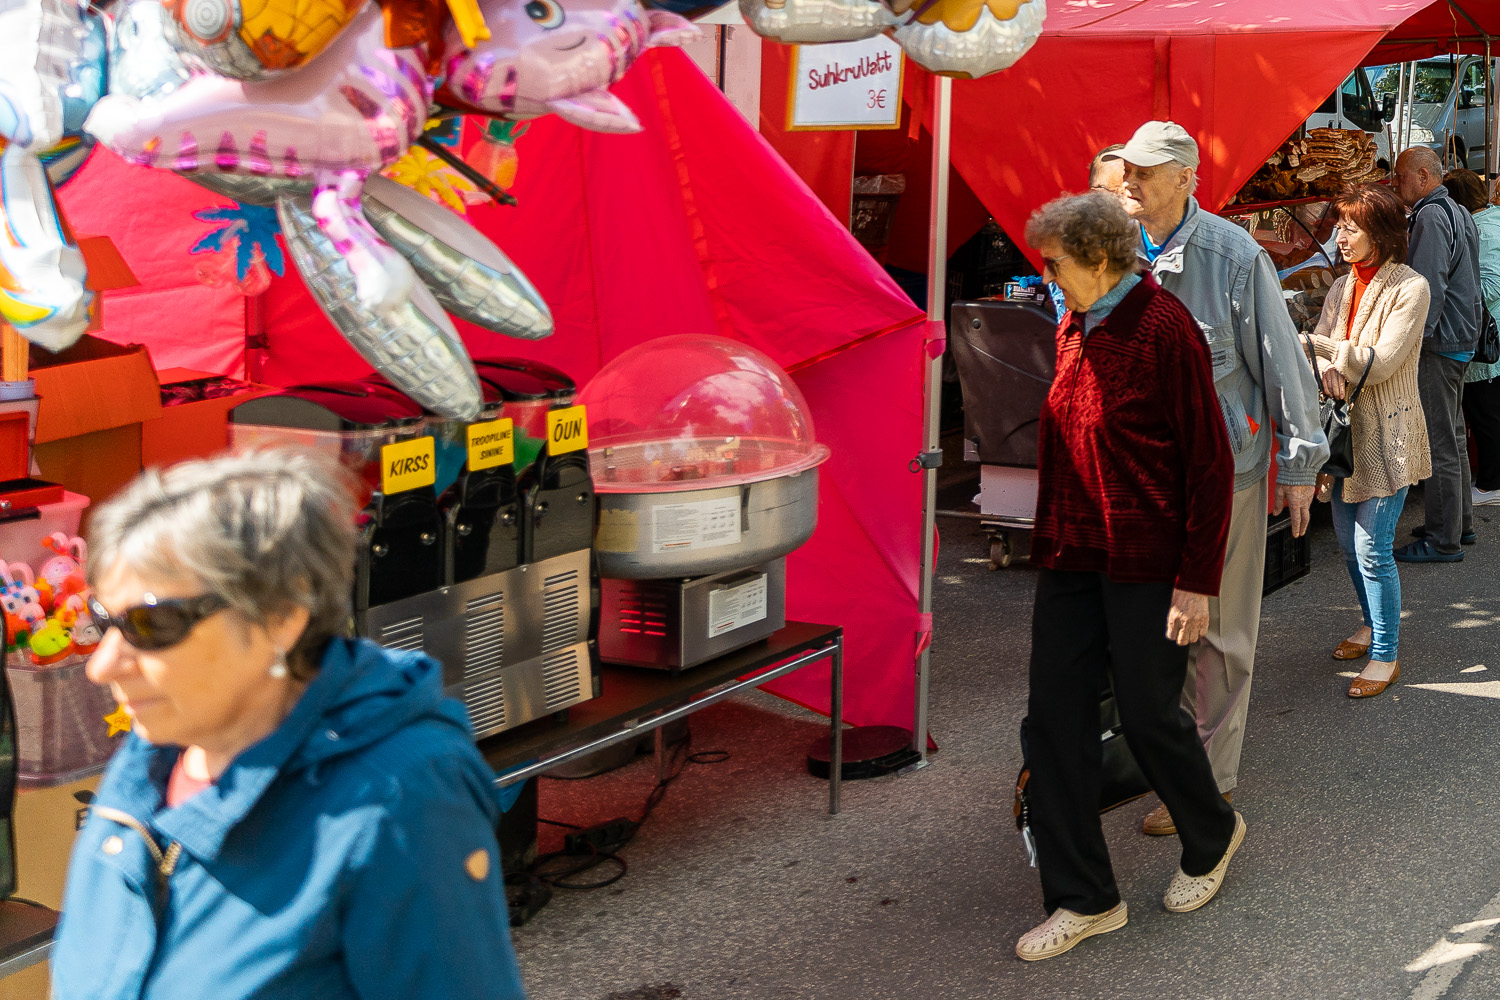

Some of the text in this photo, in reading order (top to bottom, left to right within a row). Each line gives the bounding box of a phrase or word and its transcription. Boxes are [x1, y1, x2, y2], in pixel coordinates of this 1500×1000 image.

[866, 88, 888, 109] 3€
[470, 428, 512, 448] TROOPILINE
[553, 417, 583, 443] ÕUN
[479, 446, 504, 460] SININE
[389, 453, 431, 478] KIRSS
